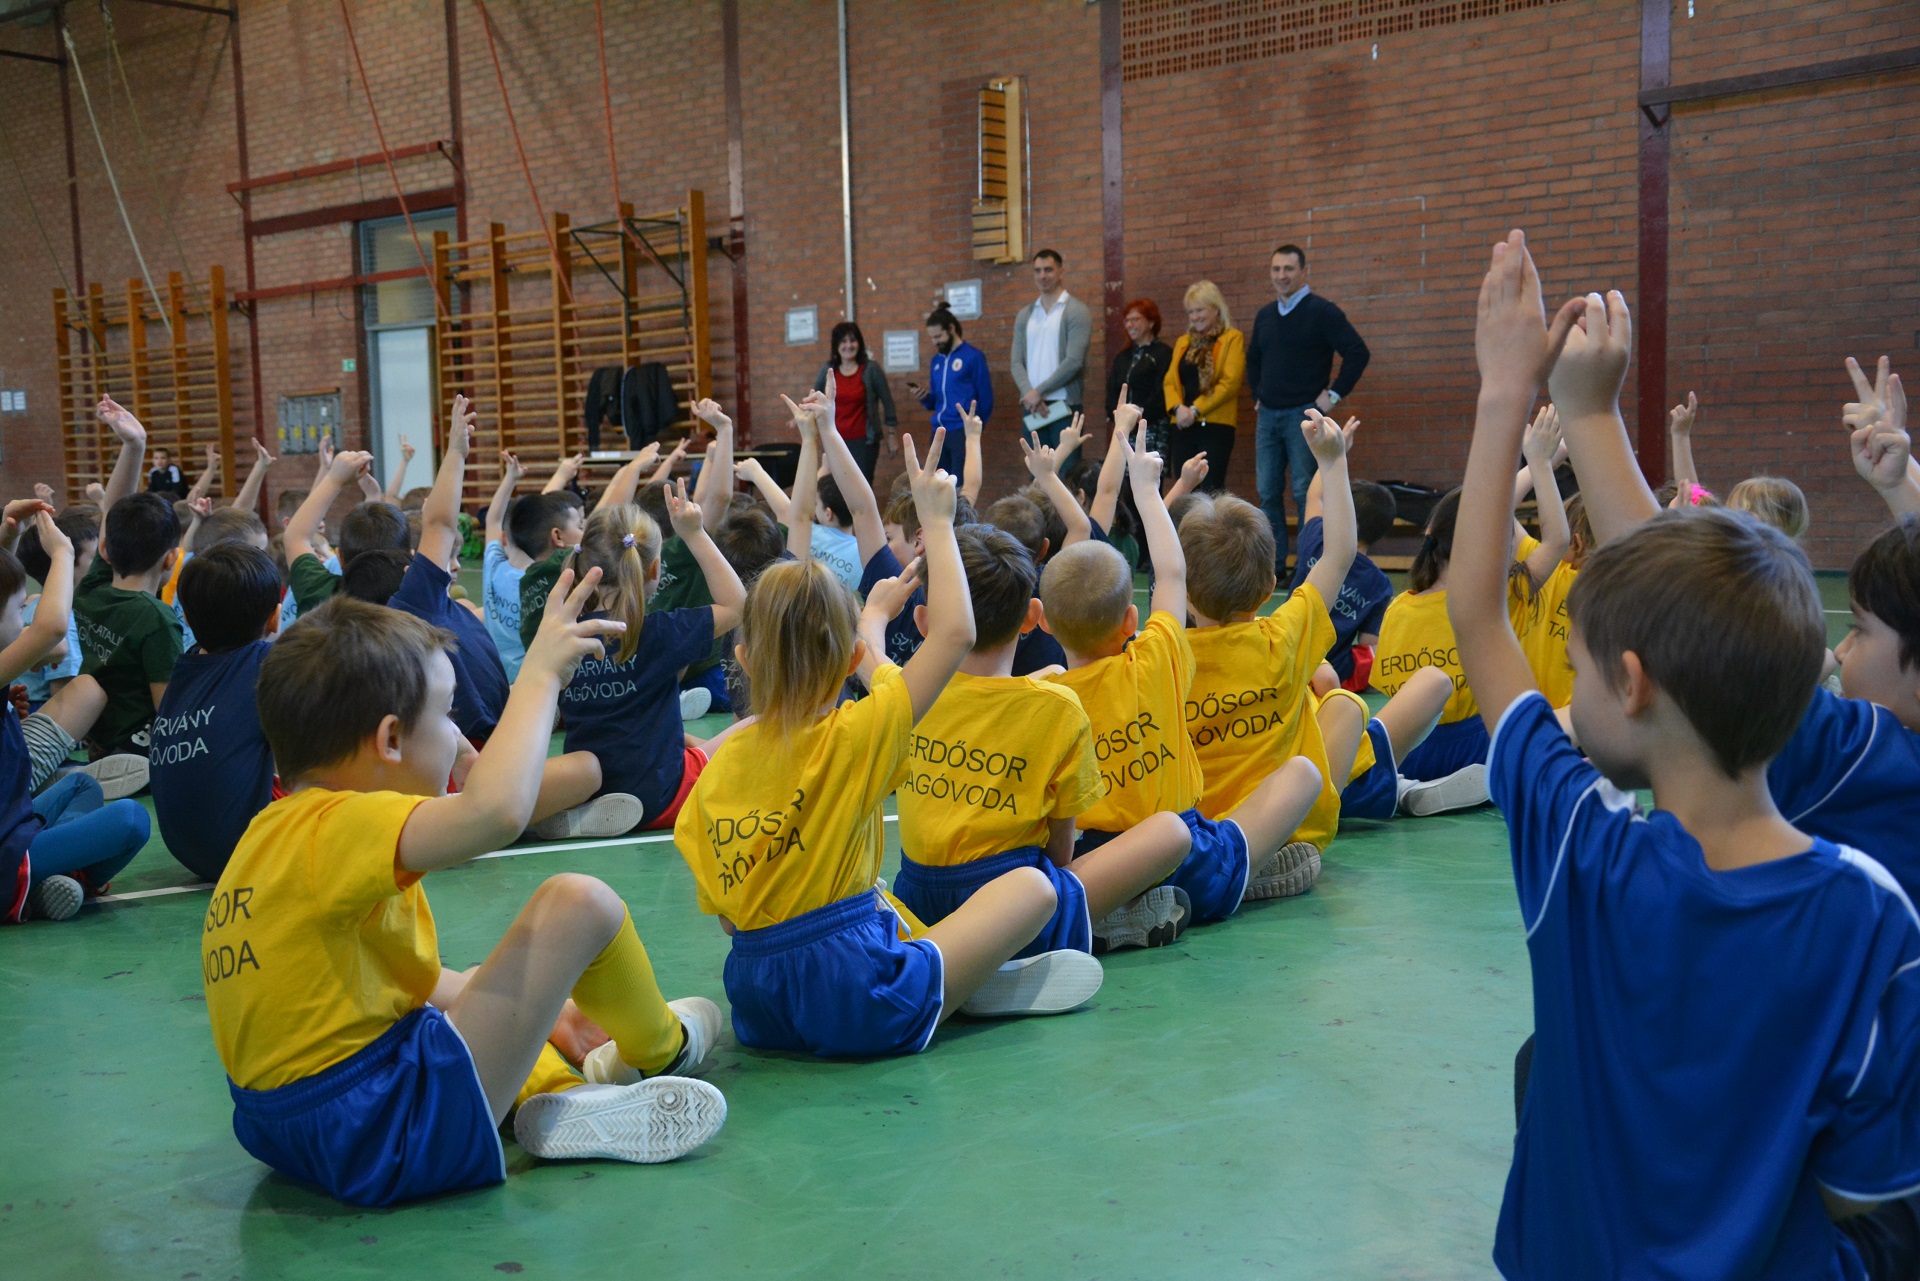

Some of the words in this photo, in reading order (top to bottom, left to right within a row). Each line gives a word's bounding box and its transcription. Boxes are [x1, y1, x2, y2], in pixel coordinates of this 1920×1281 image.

[911, 733, 1027, 782] RDŐSOR
[206, 887, 254, 932] SOR
[202, 940, 260, 986] VODA
